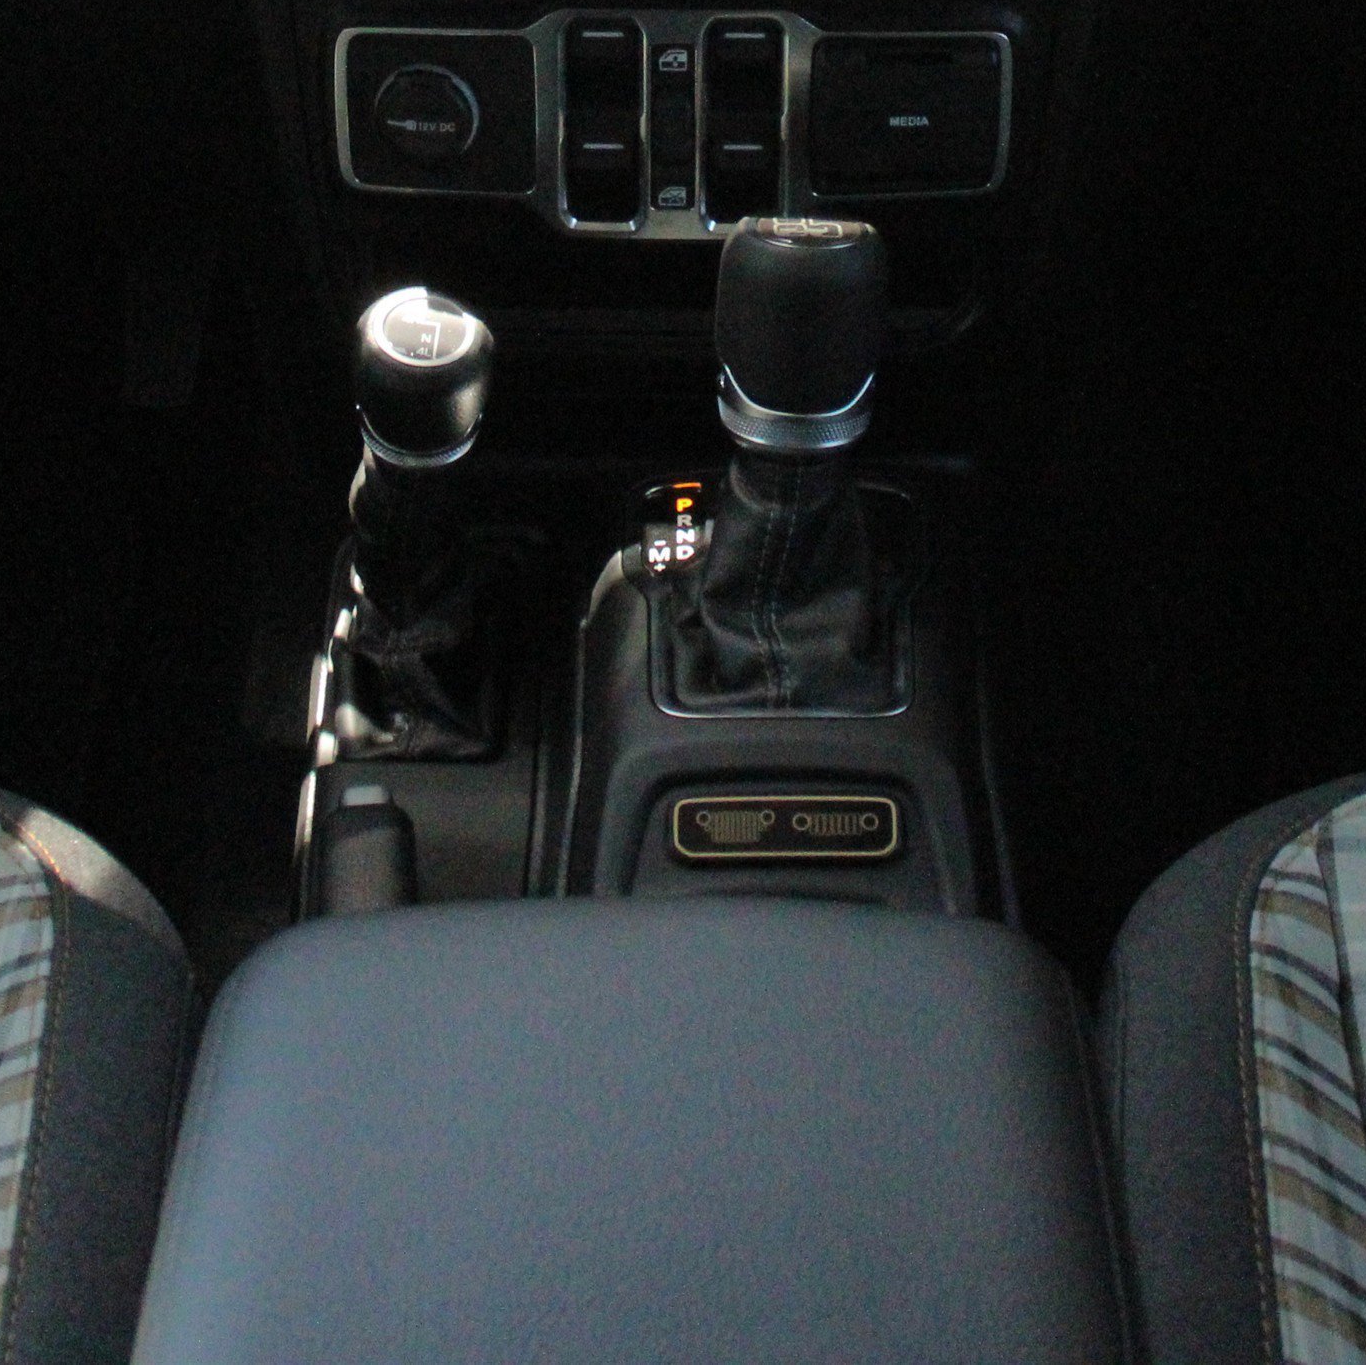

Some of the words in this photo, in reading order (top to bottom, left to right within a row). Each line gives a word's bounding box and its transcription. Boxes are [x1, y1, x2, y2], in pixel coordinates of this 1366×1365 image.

[439, 122, 456, 132] DC
[889, 116, 930, 127] MEDIA
[676, 497, 694, 513] P
[676, 514, 693, 527] R
[676, 528, 696, 544] N
[648, 547, 671, 563] M
[676, 545, 696, 561] D
